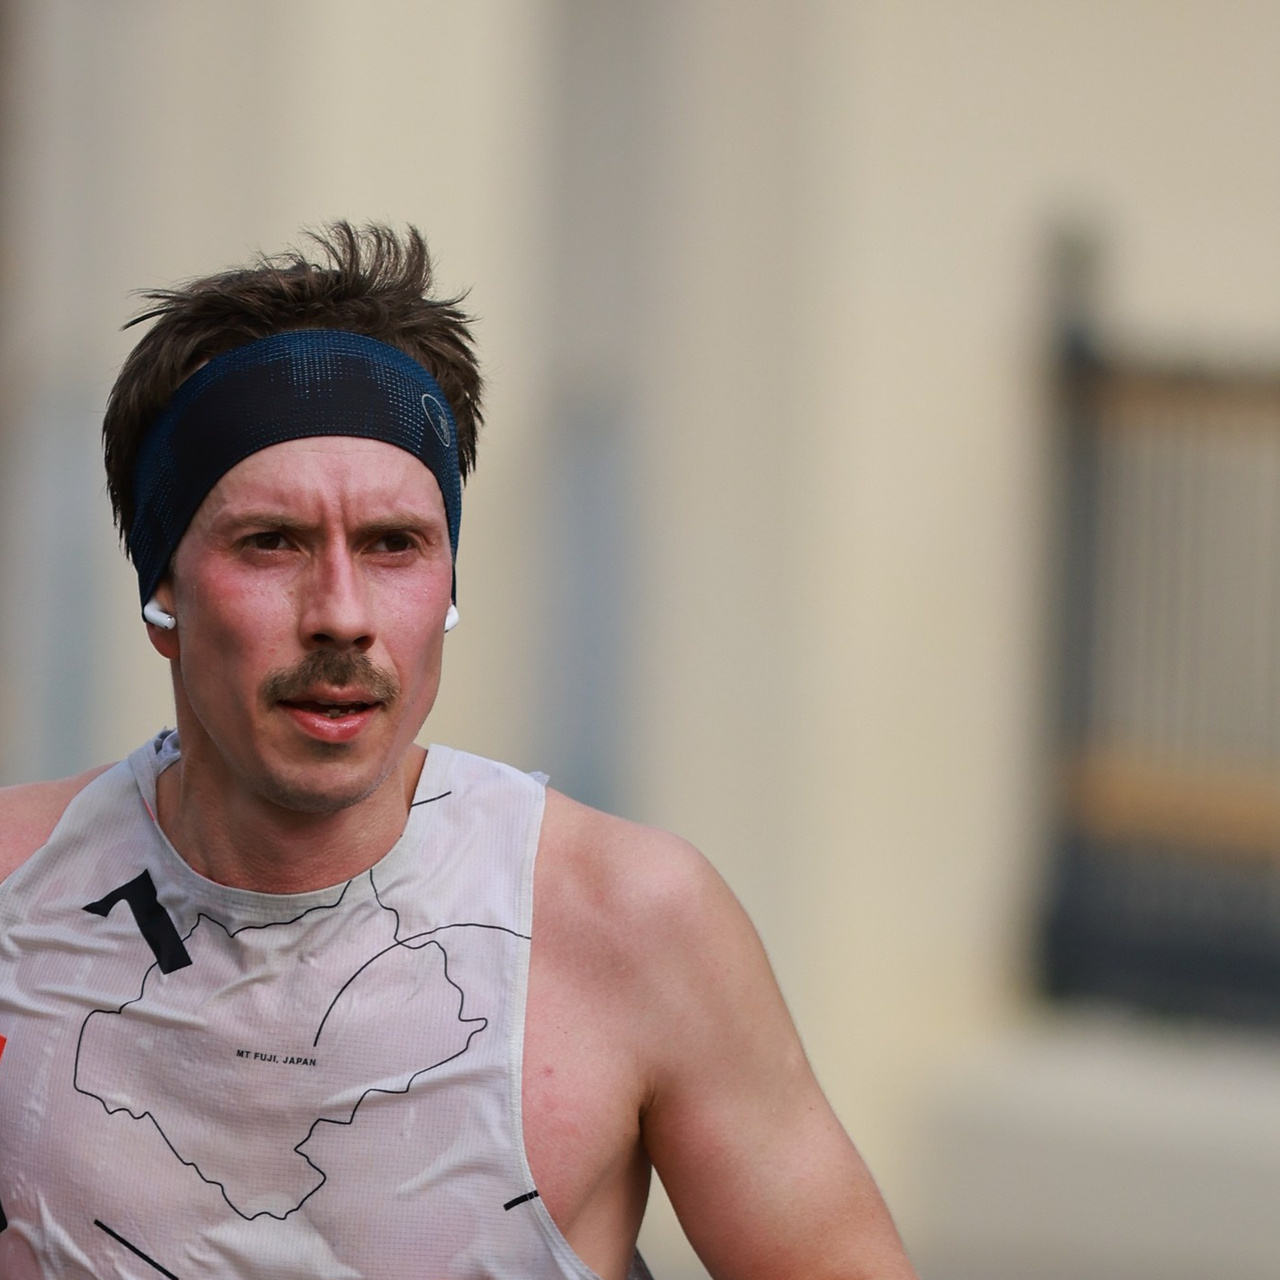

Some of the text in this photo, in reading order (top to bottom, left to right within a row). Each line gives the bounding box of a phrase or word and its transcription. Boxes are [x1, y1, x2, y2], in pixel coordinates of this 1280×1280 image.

[236, 1049, 317, 1066] MT FUJI, JAPAN
